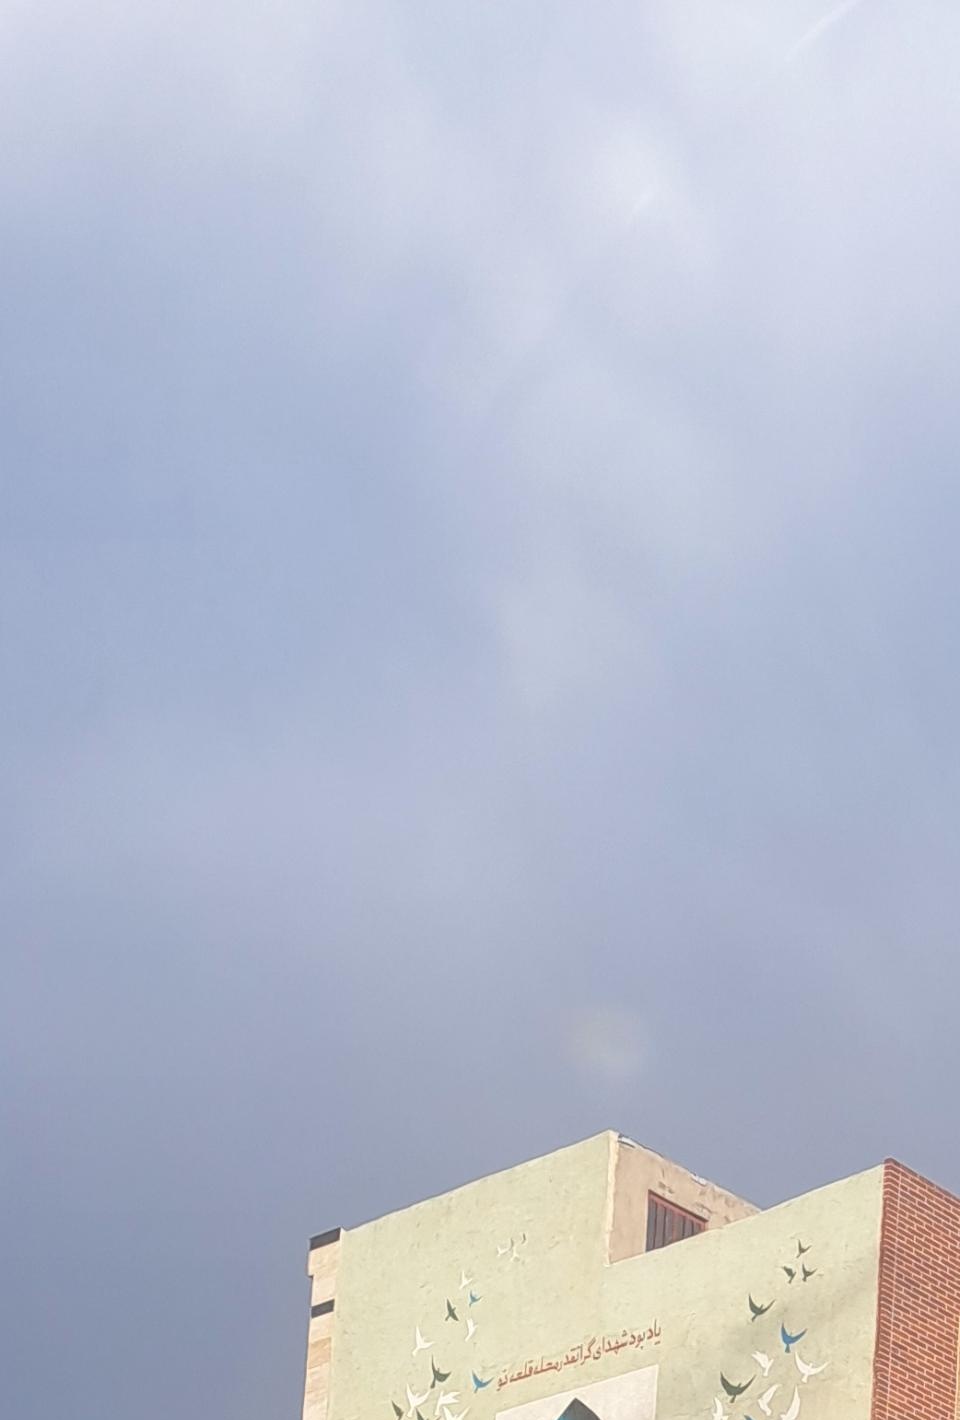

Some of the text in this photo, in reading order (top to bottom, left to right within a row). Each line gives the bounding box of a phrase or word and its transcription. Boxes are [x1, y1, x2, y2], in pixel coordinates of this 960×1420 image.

[557, 1337, 597, 1371] گرانقدر
[593, 1329, 628, 1361] شهدای
[509, 1359, 535, 1383] قلعه
[534, 1355, 560, 1375] محله
[497, 1369, 509, 1392] نو
